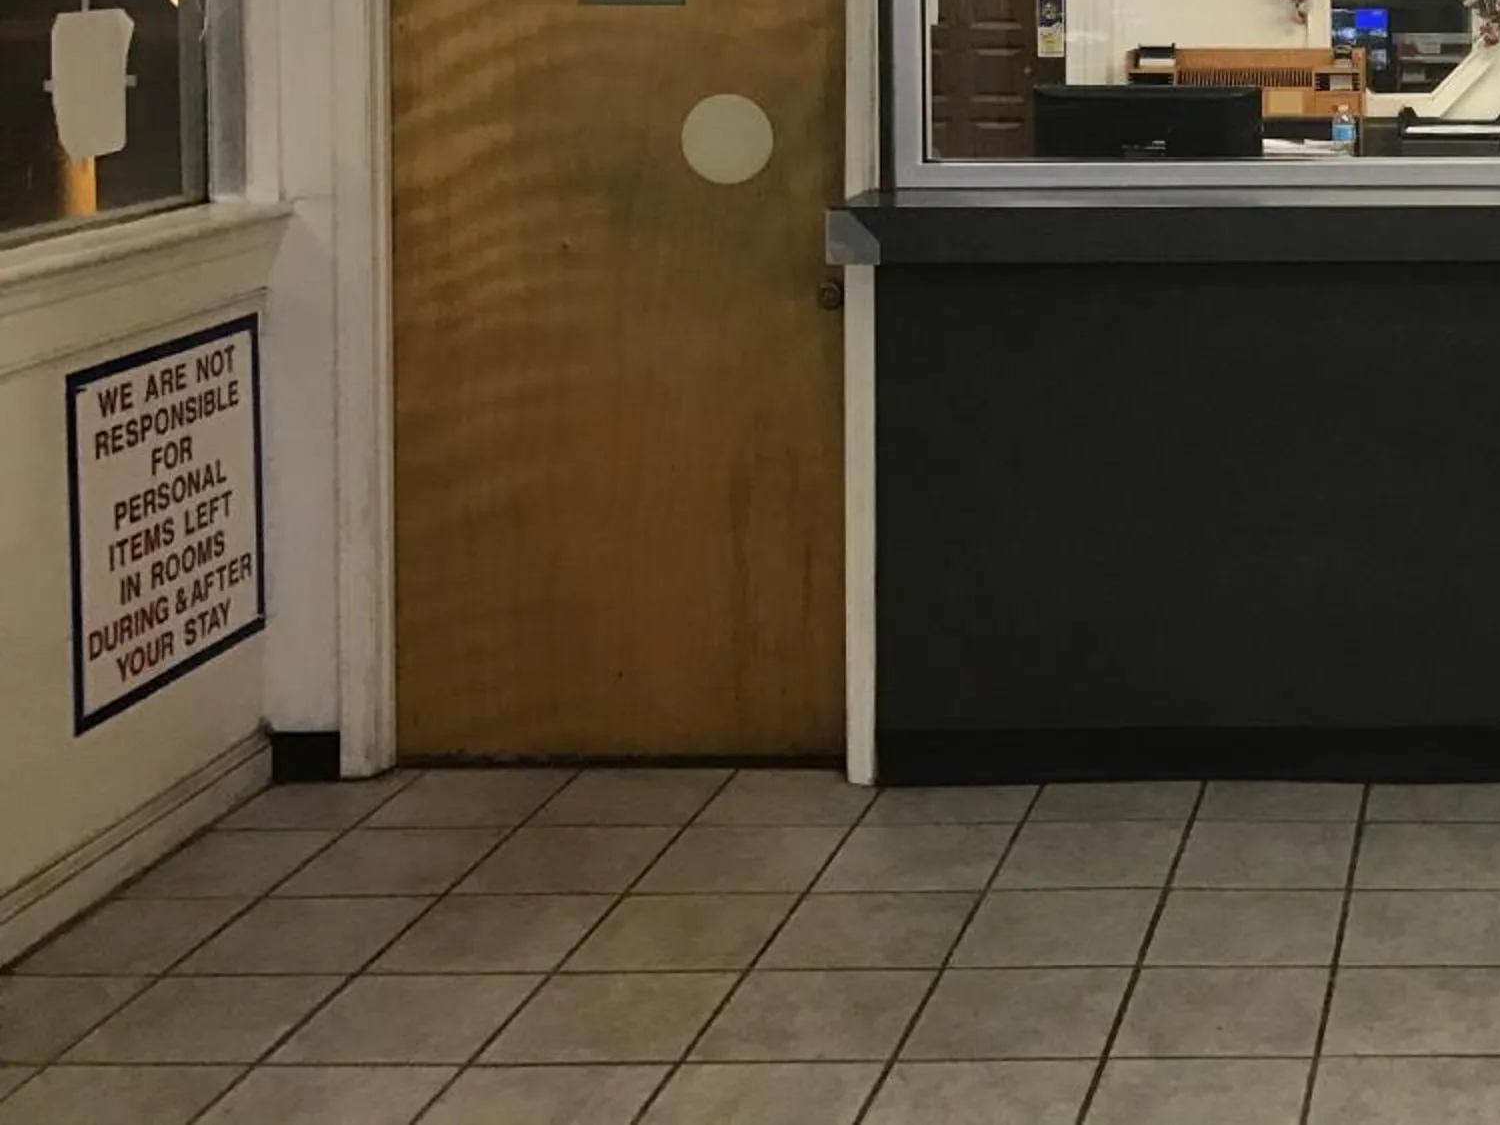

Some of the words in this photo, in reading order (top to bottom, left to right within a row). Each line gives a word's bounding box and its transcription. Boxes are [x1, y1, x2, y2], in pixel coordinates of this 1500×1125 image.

[97, 381, 134, 418] WE
[144, 363, 189, 403] ARE
[196, 344, 237, 384] NOT
[94, 380, 241, 460] RESPONSIBLE
[151, 435, 195, 476] FOR
[108, 521, 176, 572] ITEMS
[184, 490, 234, 535] LEFT
[114, 458, 228, 531] PERSONAL
[119, 572, 141, 606] IN
[150, 530, 227, 589] ROOMS
[88, 596, 171, 662] DURING
[115, 630, 176, 683] YOUR
[184, 597, 233, 649] STAY
